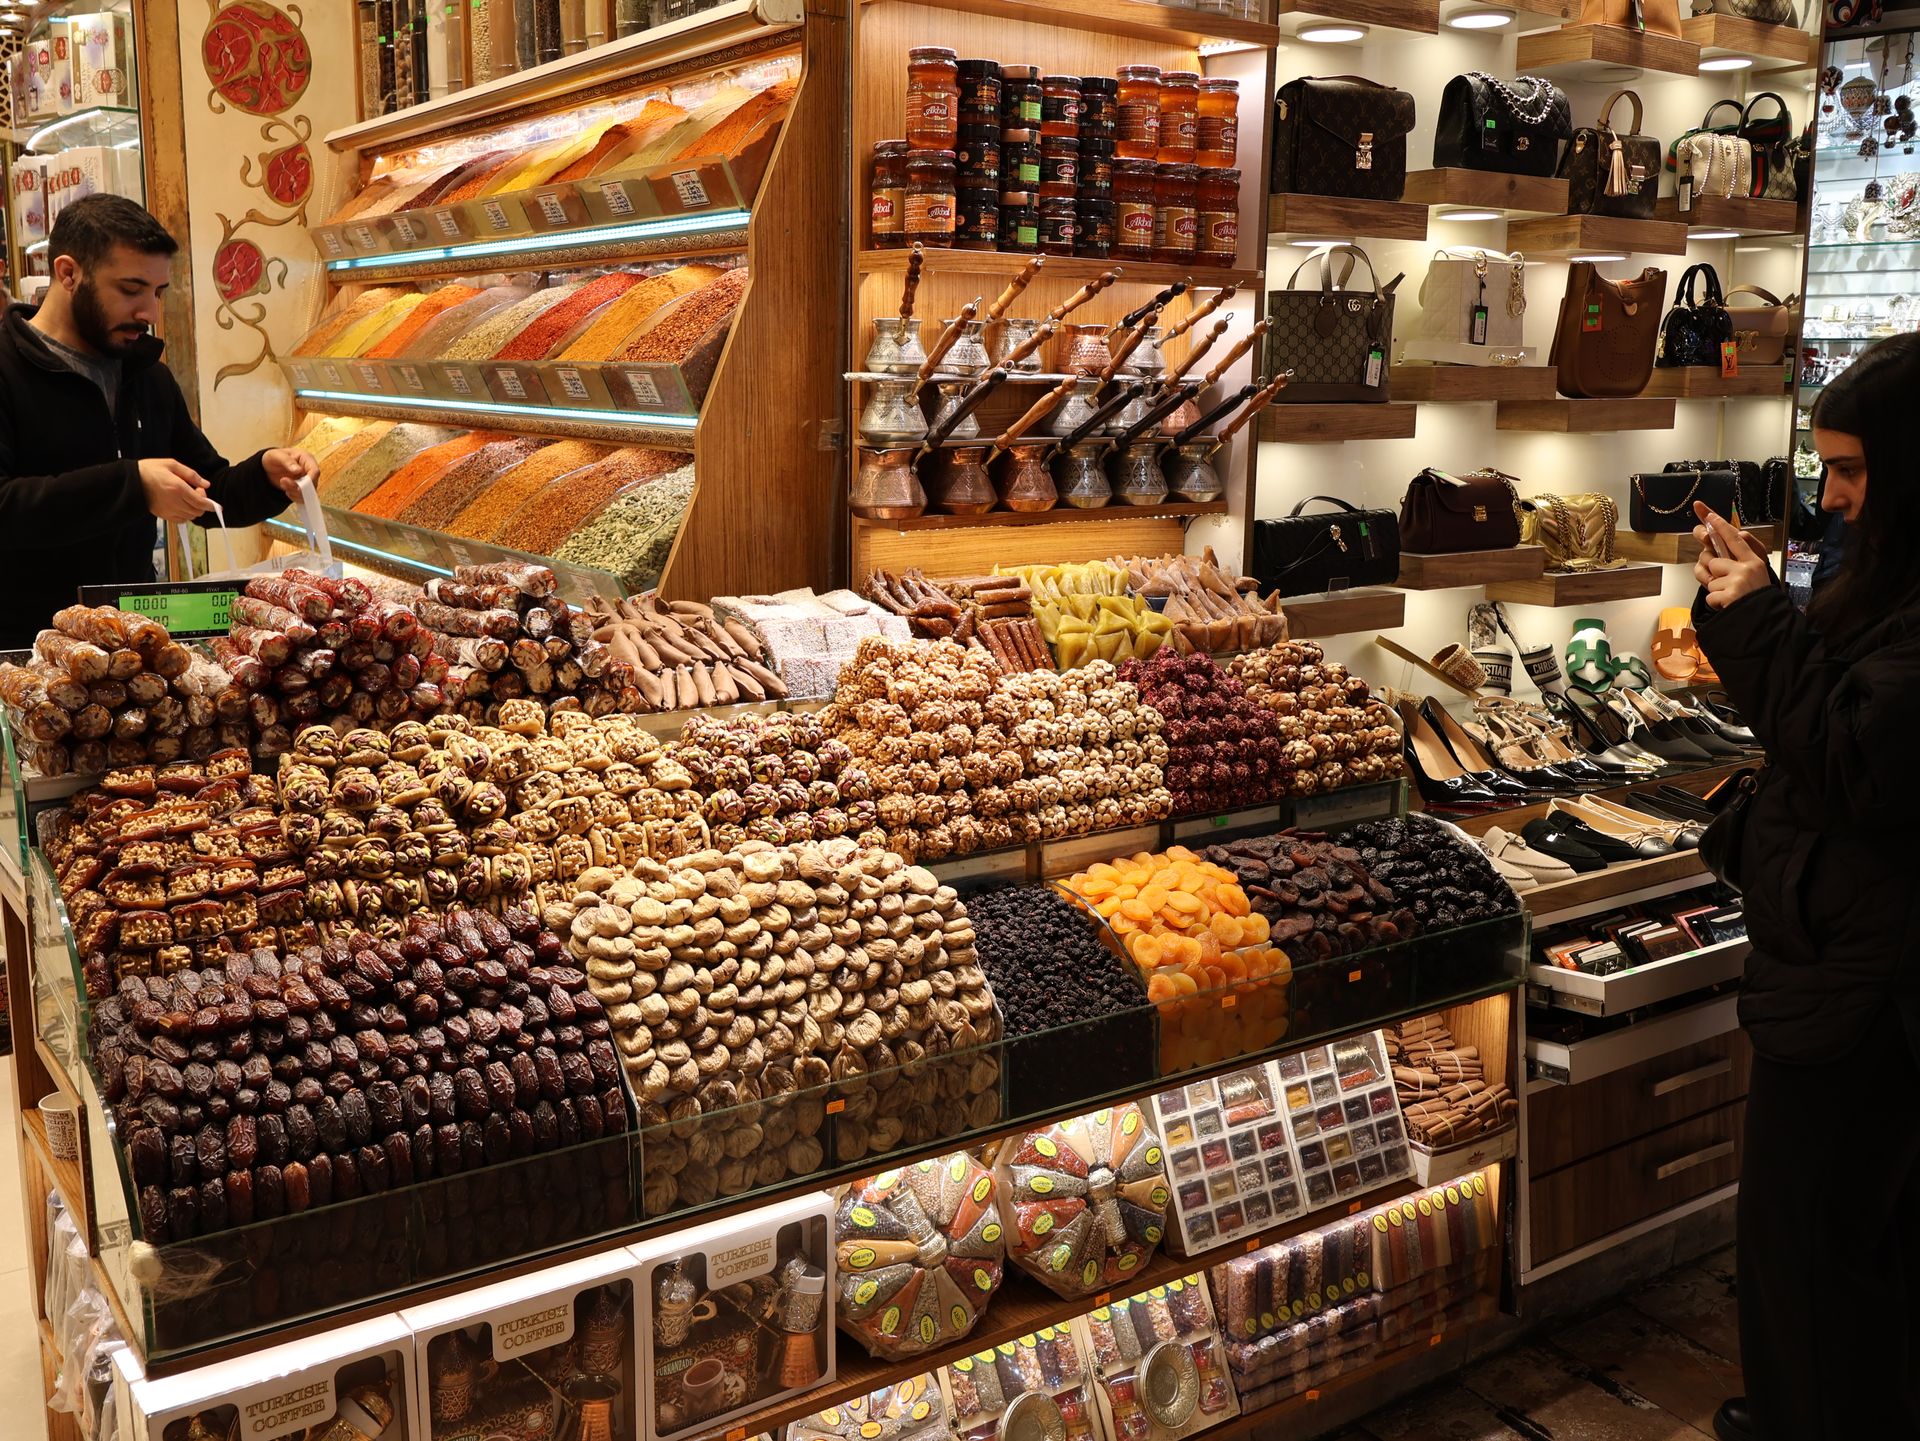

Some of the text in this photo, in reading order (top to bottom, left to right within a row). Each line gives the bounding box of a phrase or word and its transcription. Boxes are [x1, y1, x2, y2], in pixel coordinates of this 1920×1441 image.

[923, 104, 947, 116] Akbal
[1127, 216, 1152, 228] Akbal
[133, 597, 168, 612] 0,000
[711, 1237, 772, 1265] TURKISH
[715, 1252, 769, 1280] COFFEE
[498, 1304, 568, 1336] TURKISH
[503, 1320, 565, 1350] COFFEE
[656, 1358, 694, 1377] FURKANZADE
[245, 1380, 329, 1418] TURKISH
[252, 1399, 325, 1432] COFFEE
